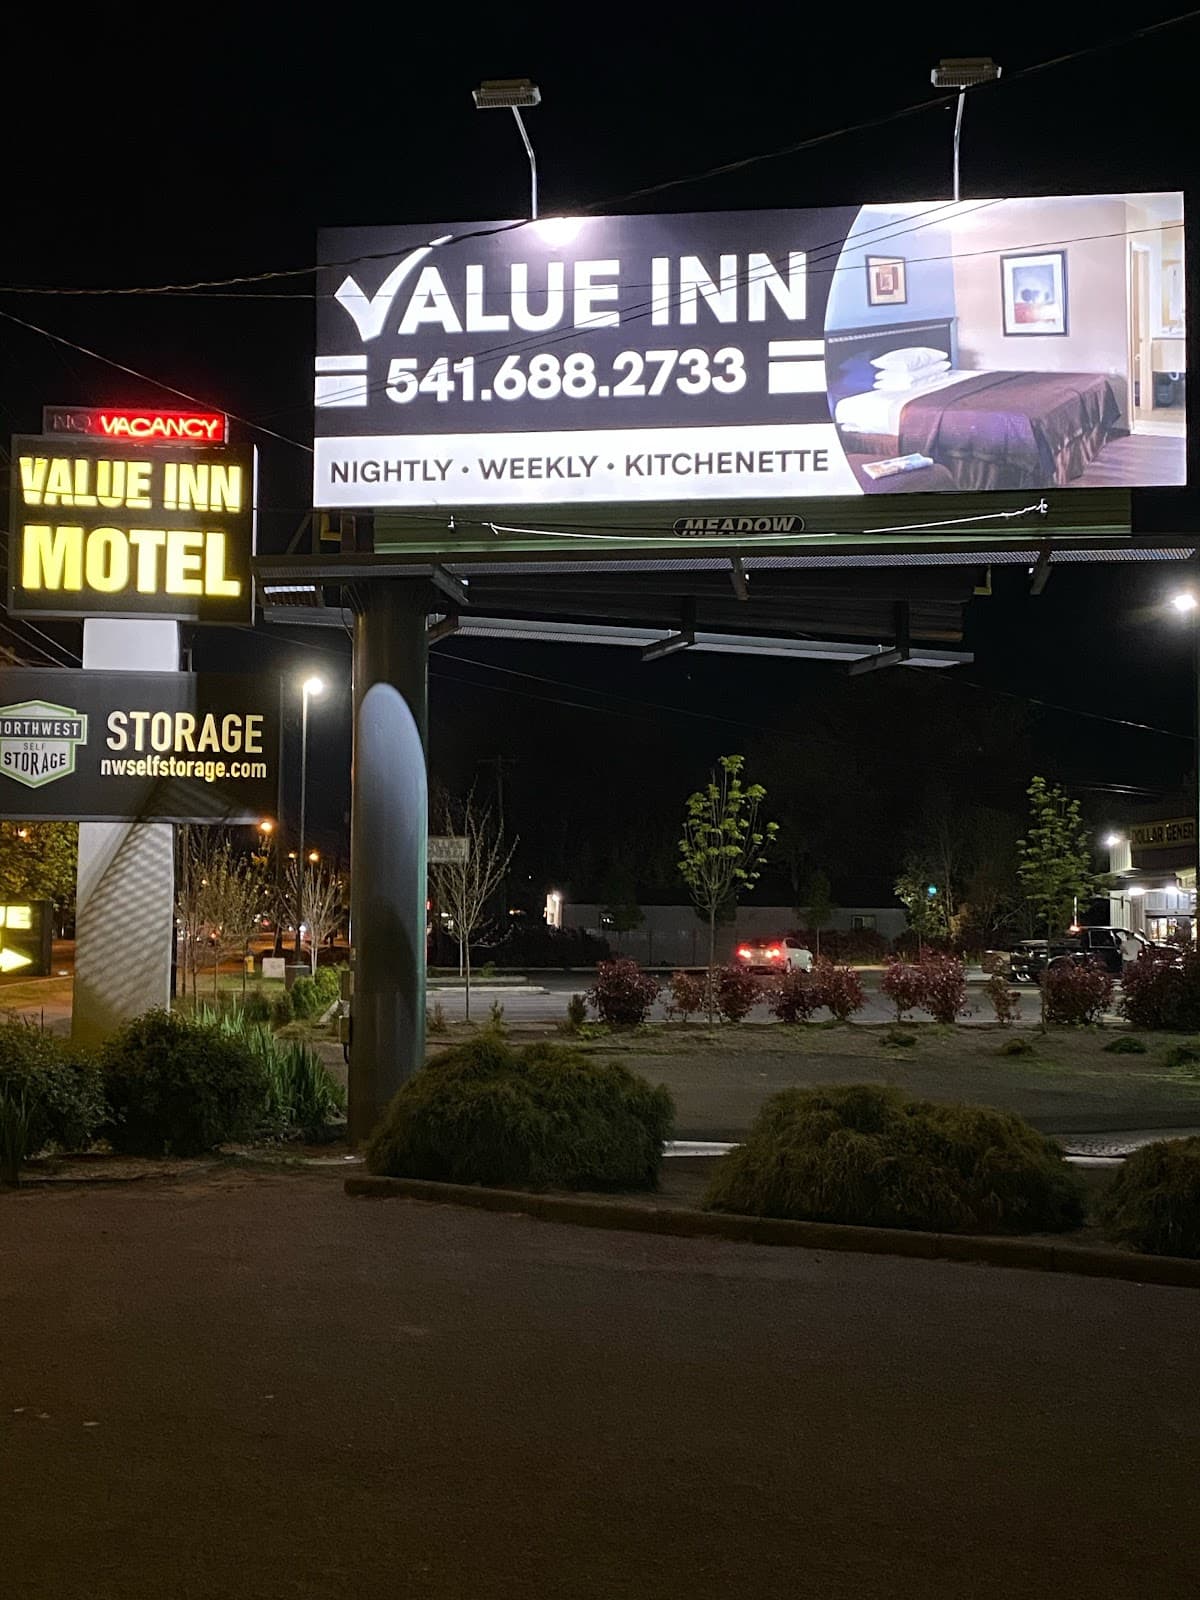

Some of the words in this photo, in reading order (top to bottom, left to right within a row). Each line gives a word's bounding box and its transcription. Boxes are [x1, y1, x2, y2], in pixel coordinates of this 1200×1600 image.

[652, 251, 807, 326] INN
[385, 347, 747, 403] 541.688.2733
[100, 415, 219, 438] VACANCY
[20, 457, 152, 509] VALUE
[163, 463, 241, 513] INN
[330, 459, 453, 483] NIGHTLY
[479, 455, 598, 480] WEEKLY
[625, 449, 829, 477] KITCHENETTE
[681, 517, 796, 535] MEADOW
[22, 525, 241, 596] MOTEL
[106, 711, 263, 753] STORAGE
[4, 752, 66, 775] STORAGE
[101, 755, 267, 782] nwselfstorage.com
